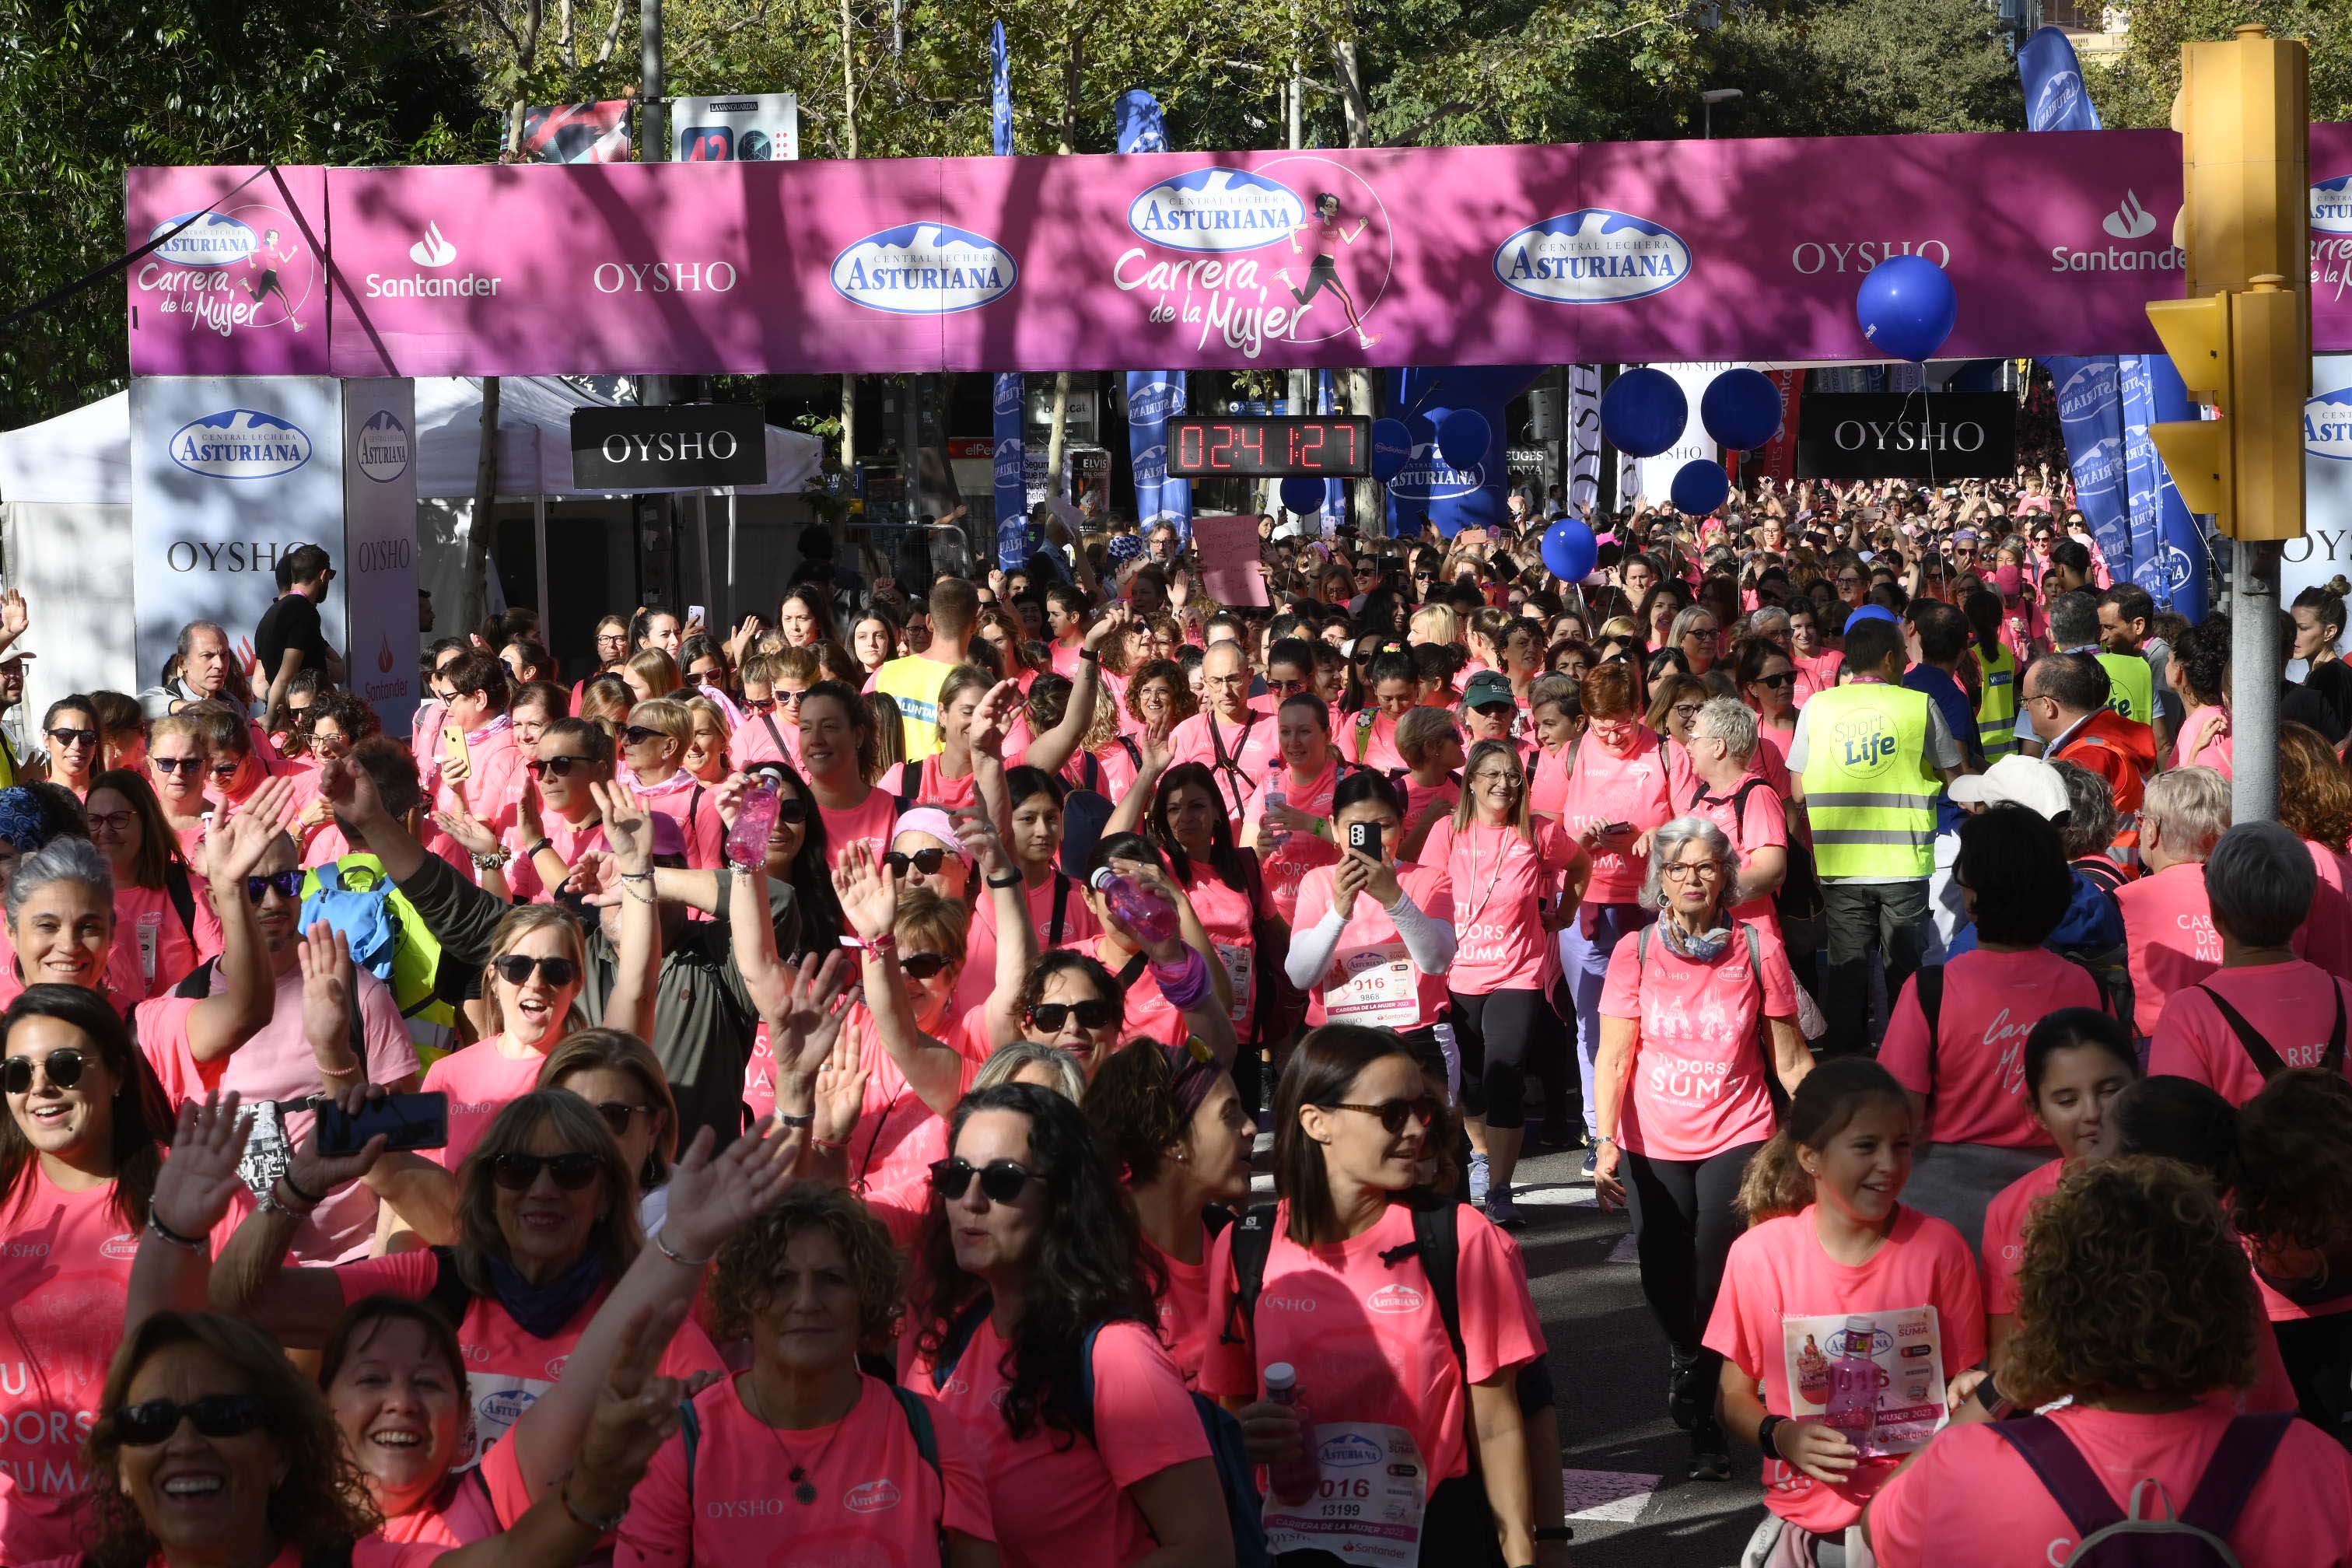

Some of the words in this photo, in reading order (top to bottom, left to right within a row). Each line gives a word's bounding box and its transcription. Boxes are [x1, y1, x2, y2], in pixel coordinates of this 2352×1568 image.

[1142, 199, 1293, 231] ASTURIANA
[873, 254, 933, 263] CENTRAL
[939, 254, 997, 262] LECHERA
[1538, 242, 1600, 252] CENTRAL
[1606, 240, 1669, 250] LECHERA
[845, 257, 1003, 290] ASTURIANA
[1113, 247, 1259, 292] Carrera
[1507, 245, 1676, 280] ASTURIANA
[2324, 261, 2338, 283] la
[138, 262, 231, 291] Carrera
[366, 273, 502, 298] Santander
[593, 261, 737, 293] OYSHO
[160, 292, 177, 313] de
[180, 292, 193, 313] la
[191, 288, 264, 338] Mujer
[1149, 294, 1176, 324] de
[1181, 291, 1202, 324] la
[1196, 285, 1314, 359] Mujer
[180, 435, 302, 461] ASTURIANA
[602, 430, 737, 463] OYSHO
[1834, 421, 1985, 452] OYSHO
[361, 436, 407, 465] ASTURIANA
[1083, 458, 1107, 468] ELVIS
[359, 537, 410, 573] OYSHO
[365, 678, 408, 701] Santander
[1832, 715, 1884, 743] Sport
[1842, 731, 1895, 766] Life
[450, 1102, 491, 1115] OYSHO
[1373, 1294, 1421, 1307] ASTURIANA
[1898, 1327, 1928, 1337] SUMA
[1878, 1411, 1908, 1422] MUJER
[1321, 1446, 1377, 1461] ASTURIANA
[1319, 1479, 1370, 1498] 016
[707, 1500, 784, 1518] OYSHO
[1321, 1504, 1360, 1517] 13199
[1275, 1517, 1318, 1531] CARRERA
[1347, 1524, 1381, 1534] MUJER
[1356, 1542, 1406, 1557] Santander
